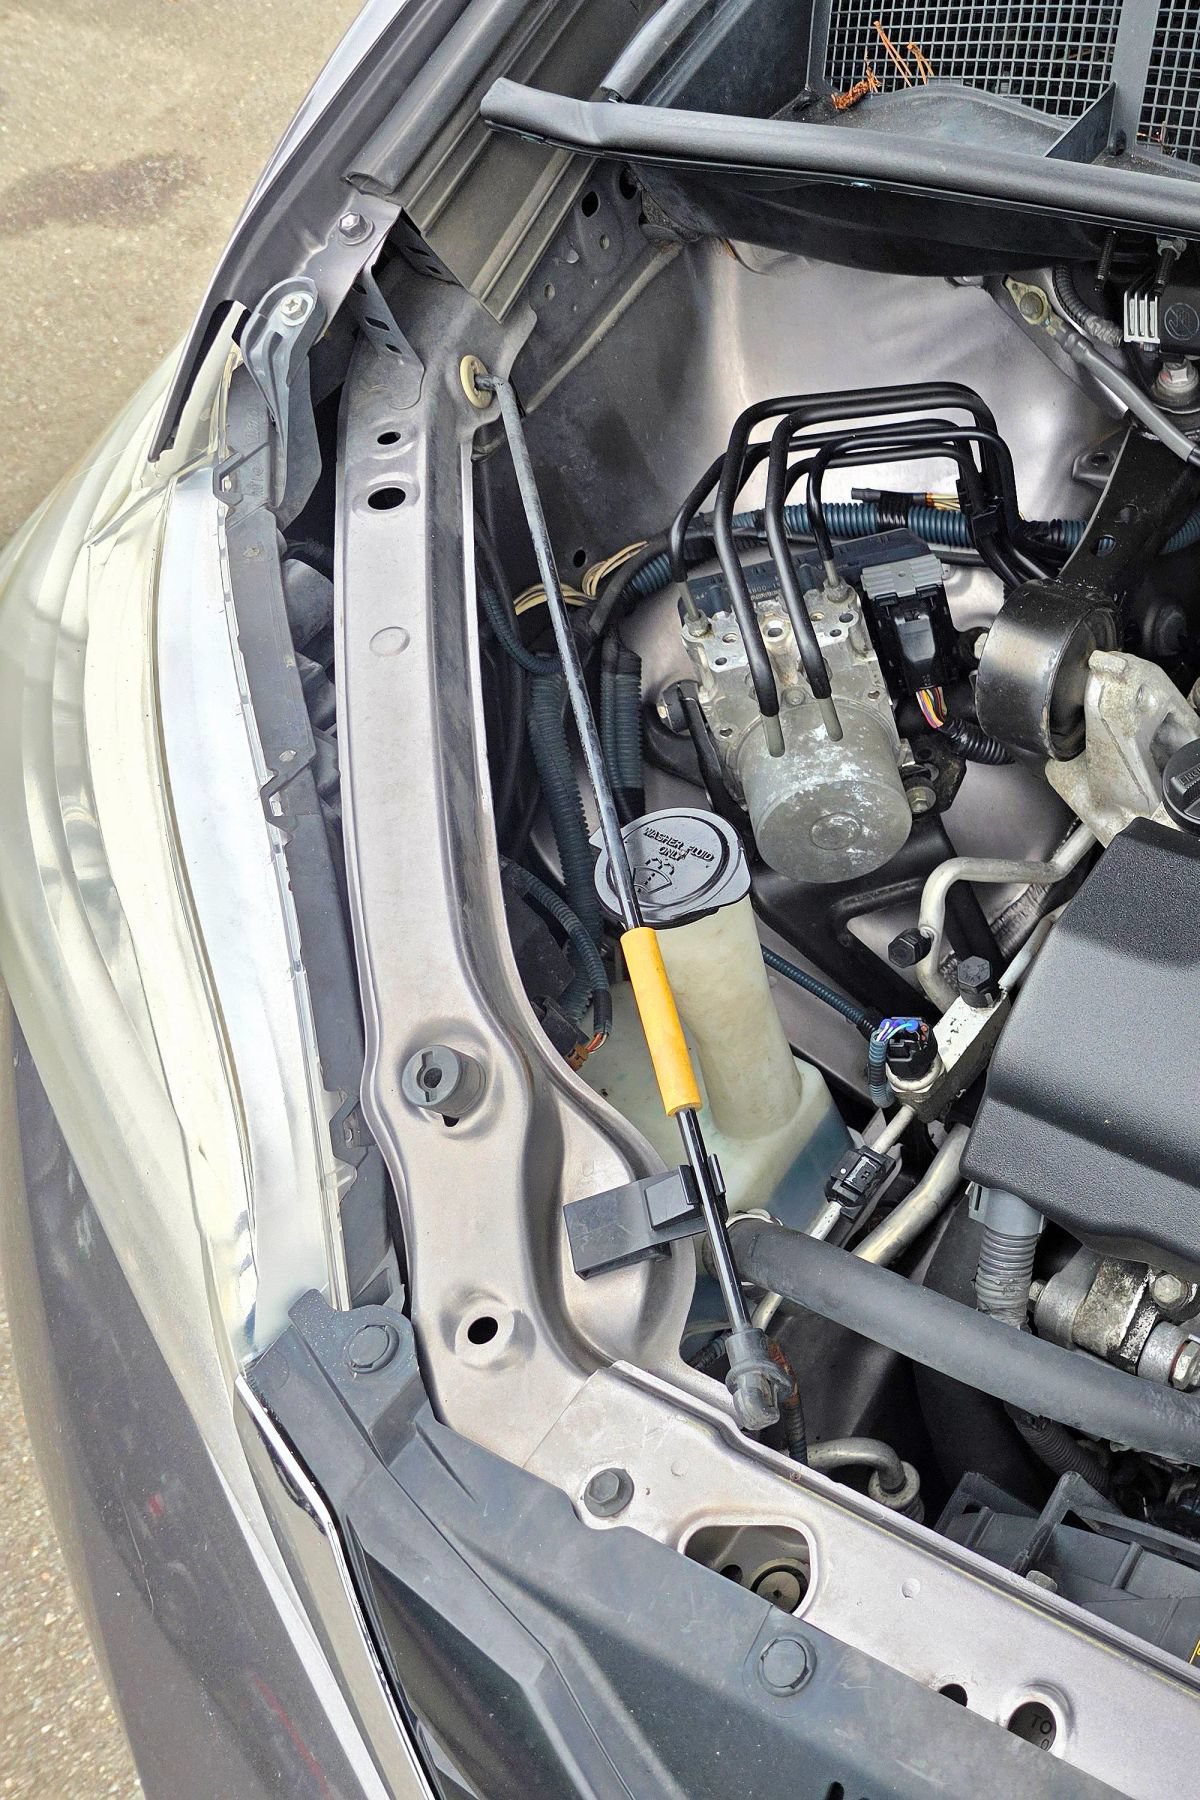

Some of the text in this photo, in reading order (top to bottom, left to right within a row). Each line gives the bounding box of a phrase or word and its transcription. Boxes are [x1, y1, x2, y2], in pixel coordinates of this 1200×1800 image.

[643, 827, 715, 862] WASHER FLUID
[658, 846, 688, 861] ONLY
